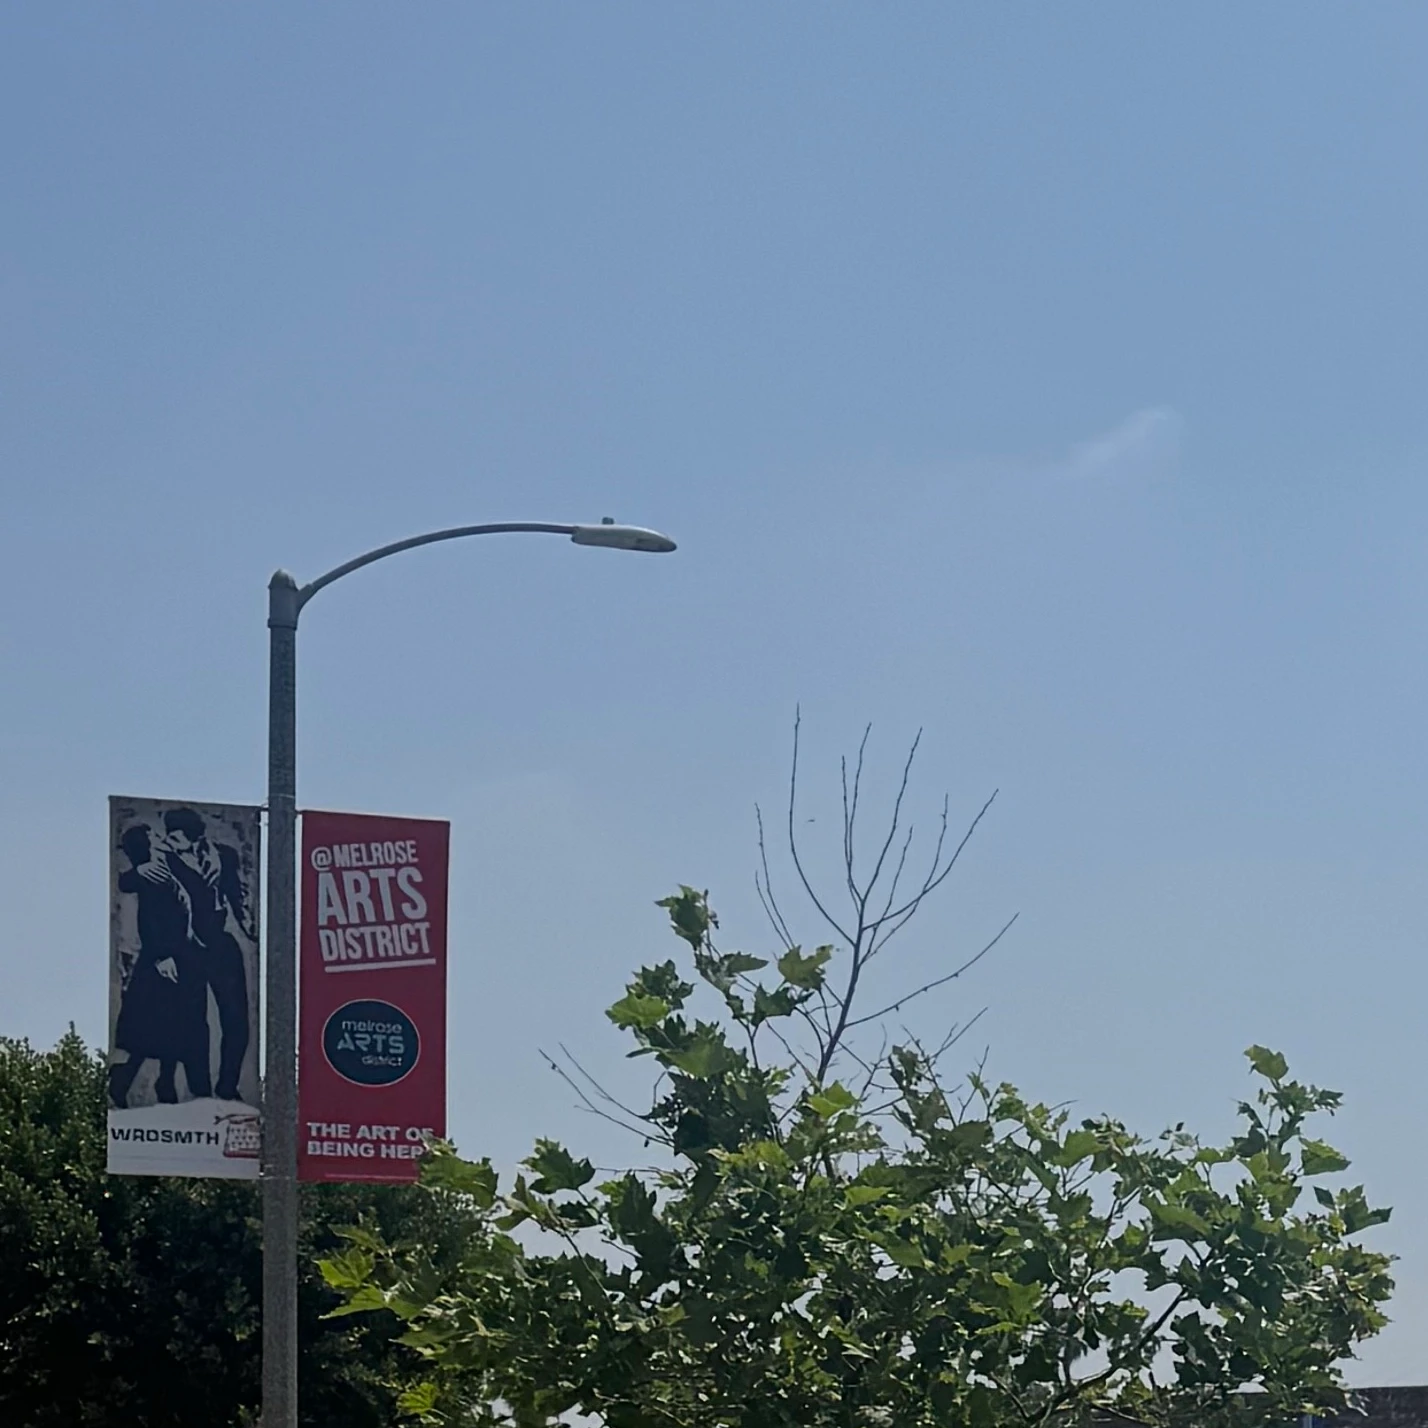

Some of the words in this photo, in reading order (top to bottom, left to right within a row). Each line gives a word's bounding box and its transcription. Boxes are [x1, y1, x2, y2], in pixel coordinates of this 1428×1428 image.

[311, 840, 419, 872] @MELROSE
[318, 866, 427, 926] ARTS
[319, 922, 431, 961] DISTRICT
[341, 1020, 403, 1034] melrose
[337, 1032, 405, 1054] ARTS
[111, 1127, 219, 1145] WRDSMTH
[306, 1122, 351, 1139] THE
[356, 1125, 400, 1140] ART
[307, 1140, 375, 1158] BEING
[380, 1143, 424, 1160] HER
